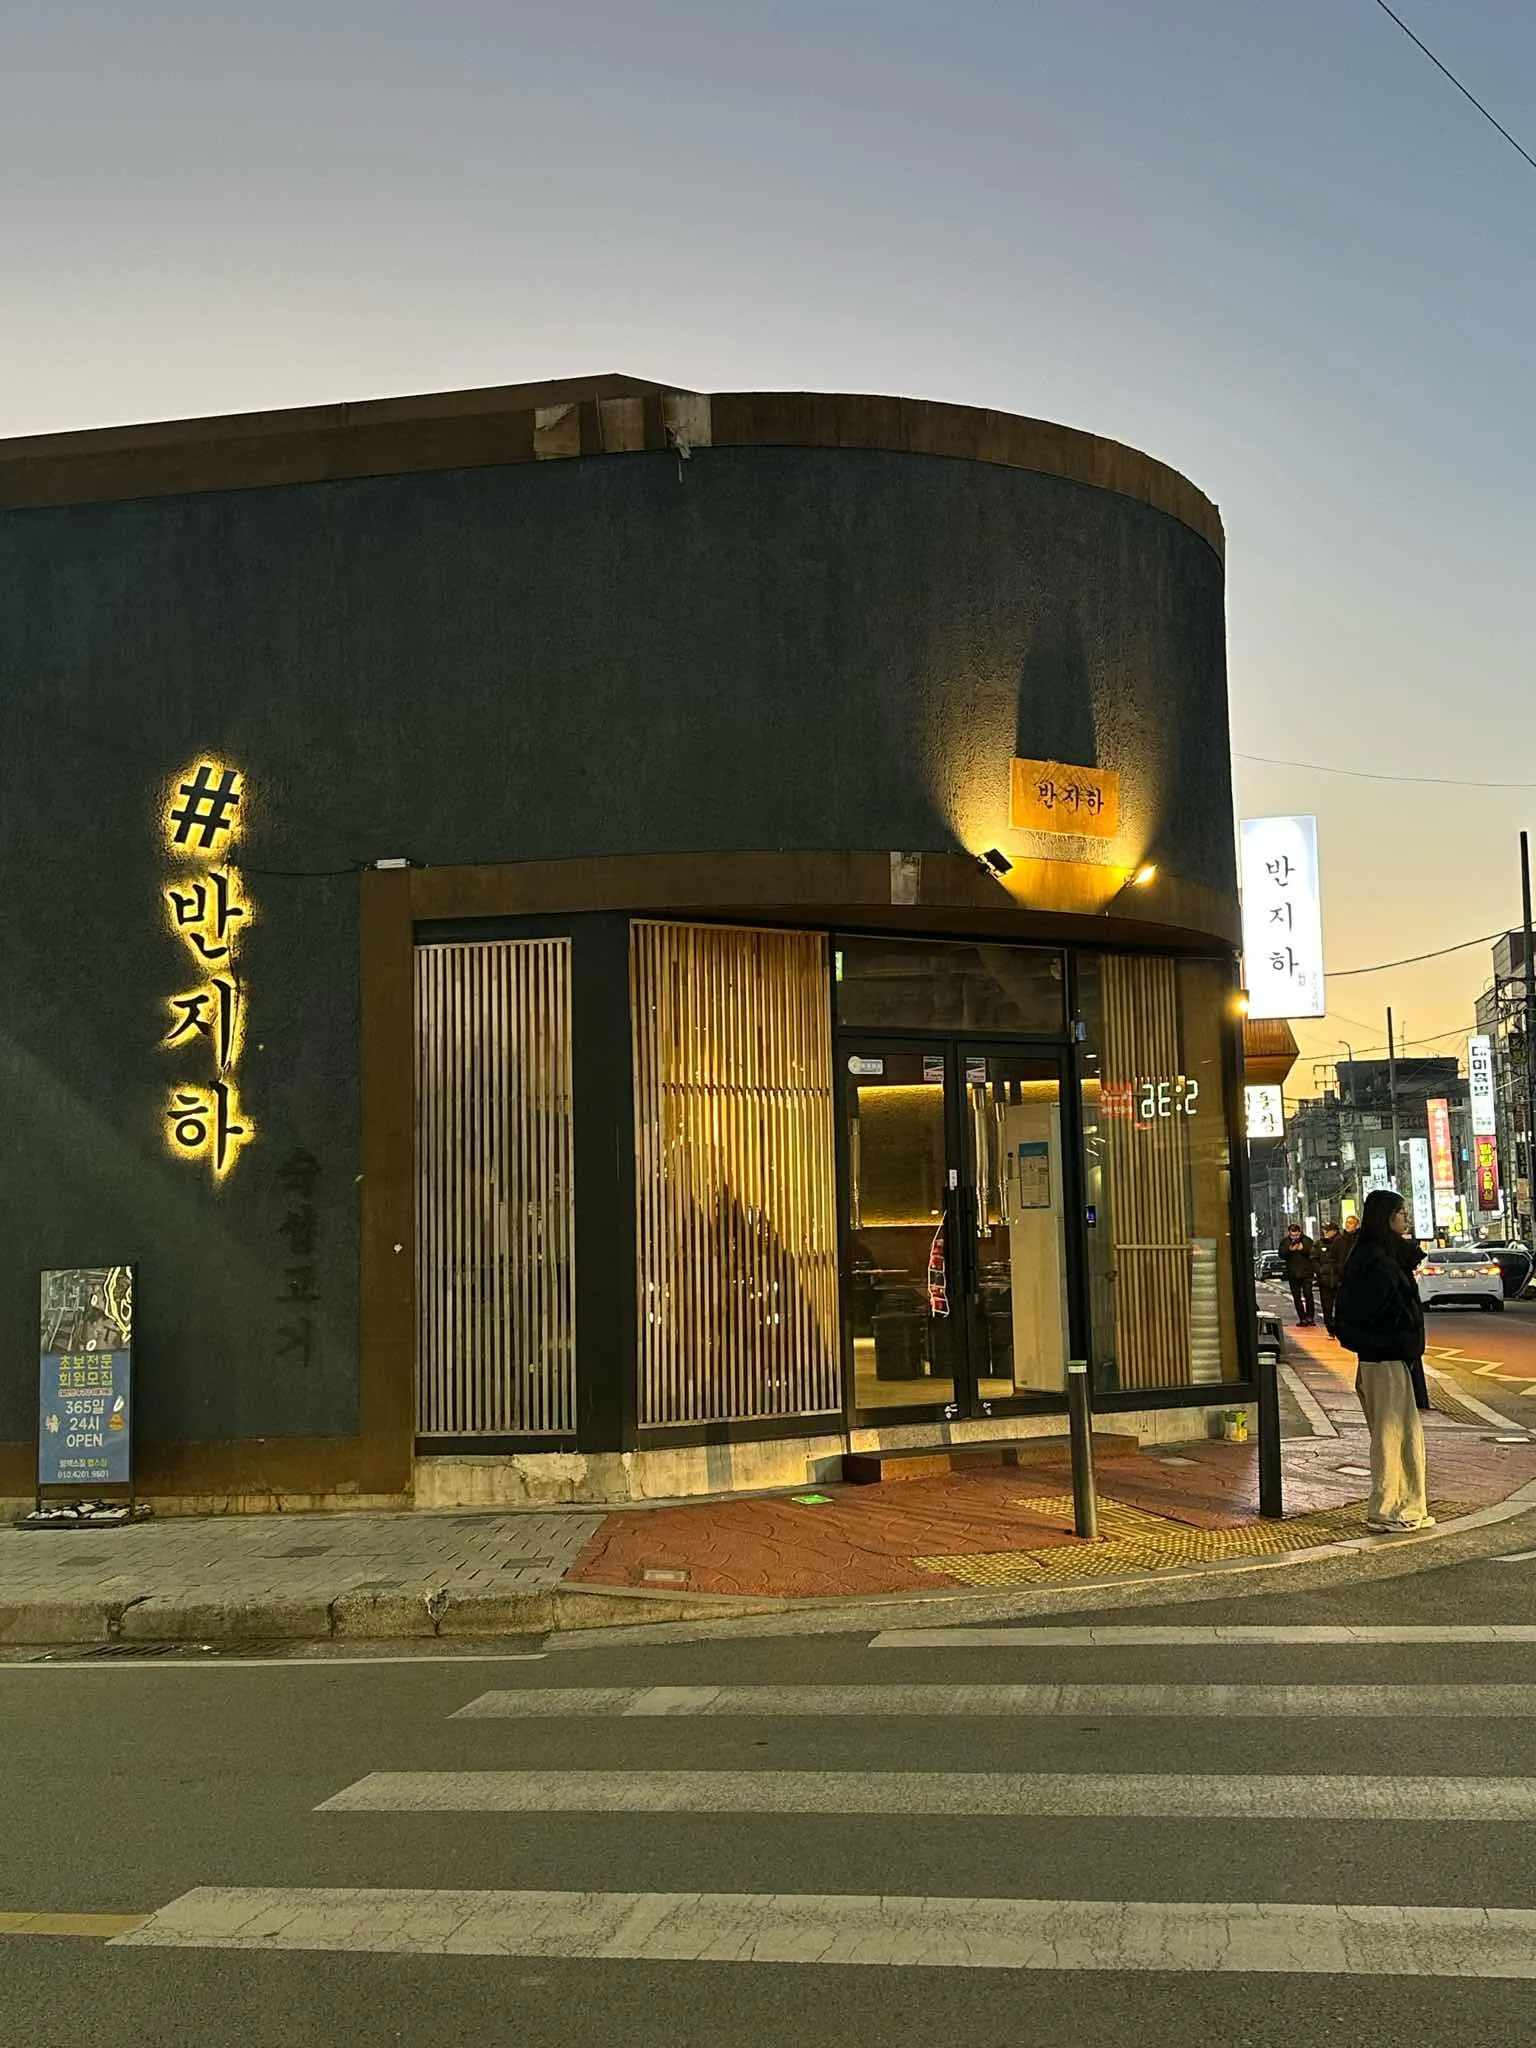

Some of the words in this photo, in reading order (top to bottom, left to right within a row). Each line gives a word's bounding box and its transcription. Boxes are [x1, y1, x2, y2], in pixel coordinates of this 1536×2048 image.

[1038, 780, 1104, 816] 반지하
[1266, 856, 1299, 977] 반지하
[59, 1354, 112, 1370] 초보전문
[59, 1371, 112, 1387] 회원모집
[65, 1399, 104, 1414] 365일
[69, 1416, 100, 1431] 24시
[66, 1433, 103, 1448] OPEN
